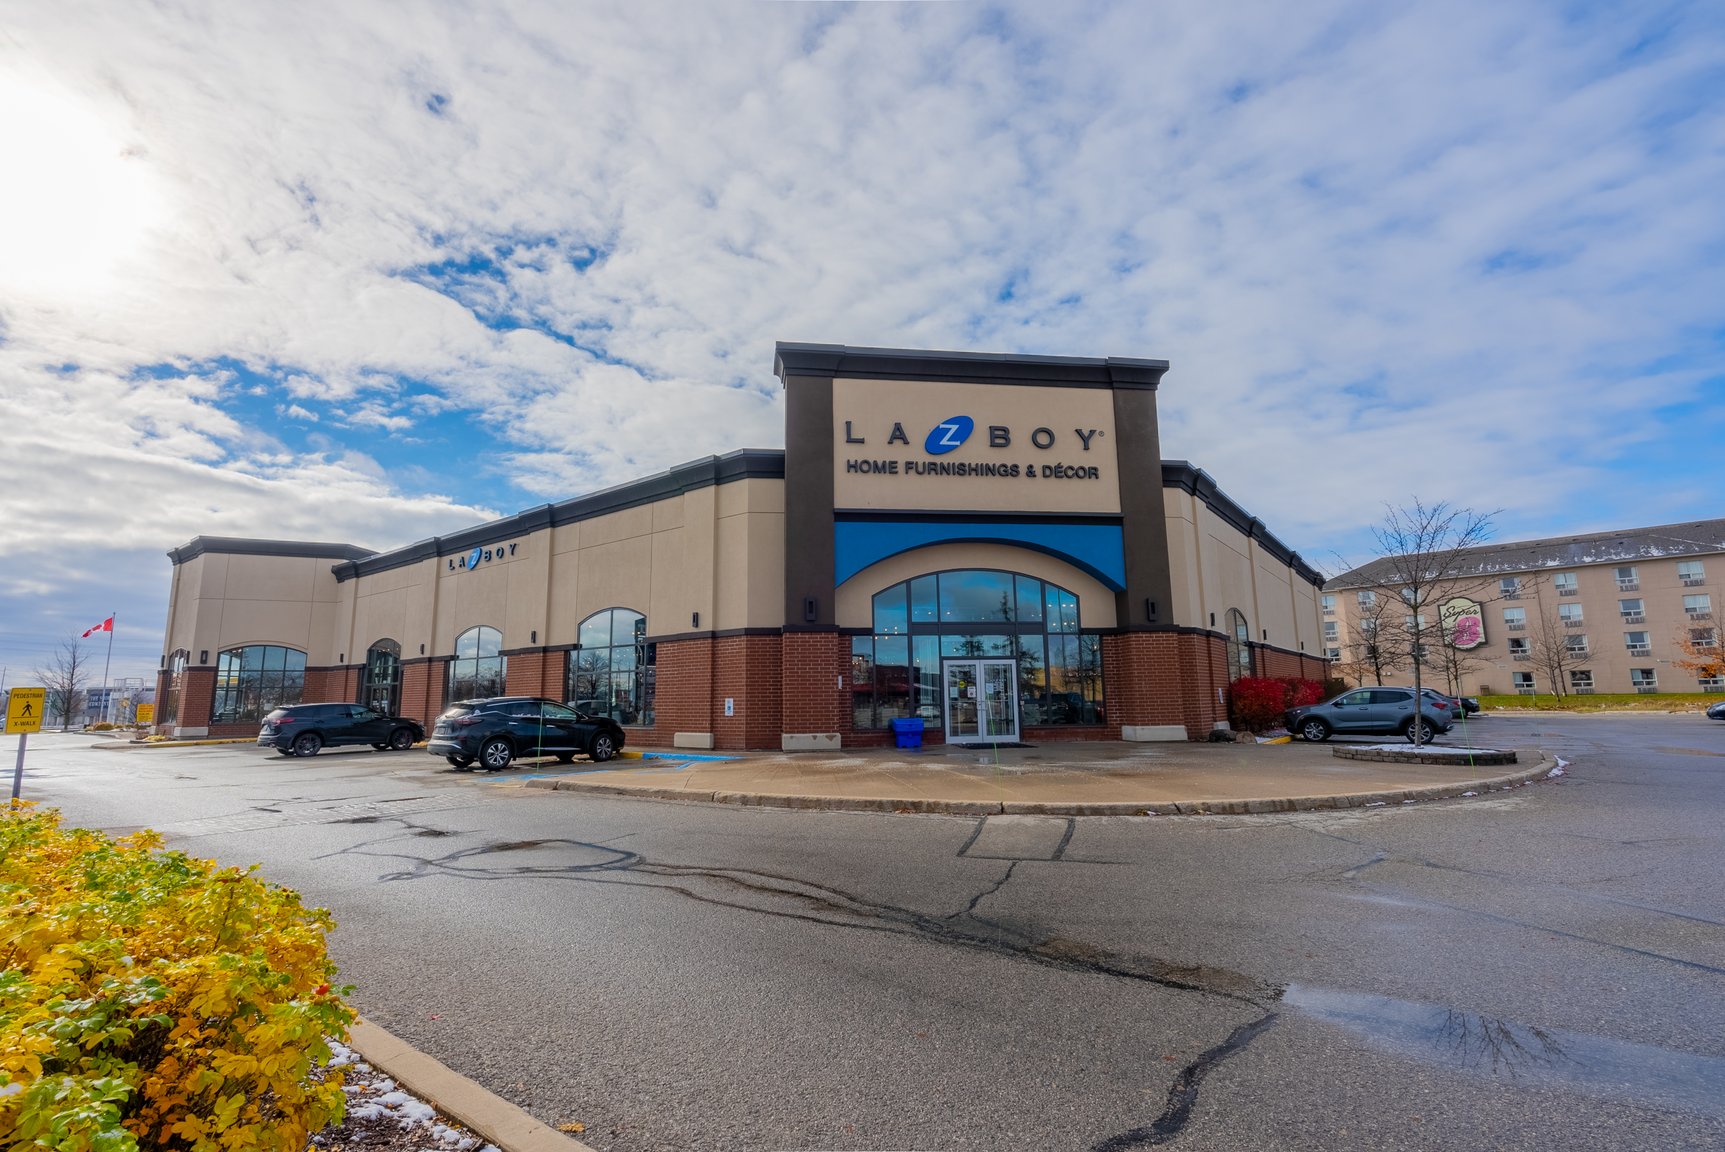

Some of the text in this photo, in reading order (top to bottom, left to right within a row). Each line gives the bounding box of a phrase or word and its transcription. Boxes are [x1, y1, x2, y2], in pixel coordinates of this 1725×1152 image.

[847, 460, 1099, 479] HOME FURNISHINGS & DÉCOR
[1443, 606, 1479, 622] Super
